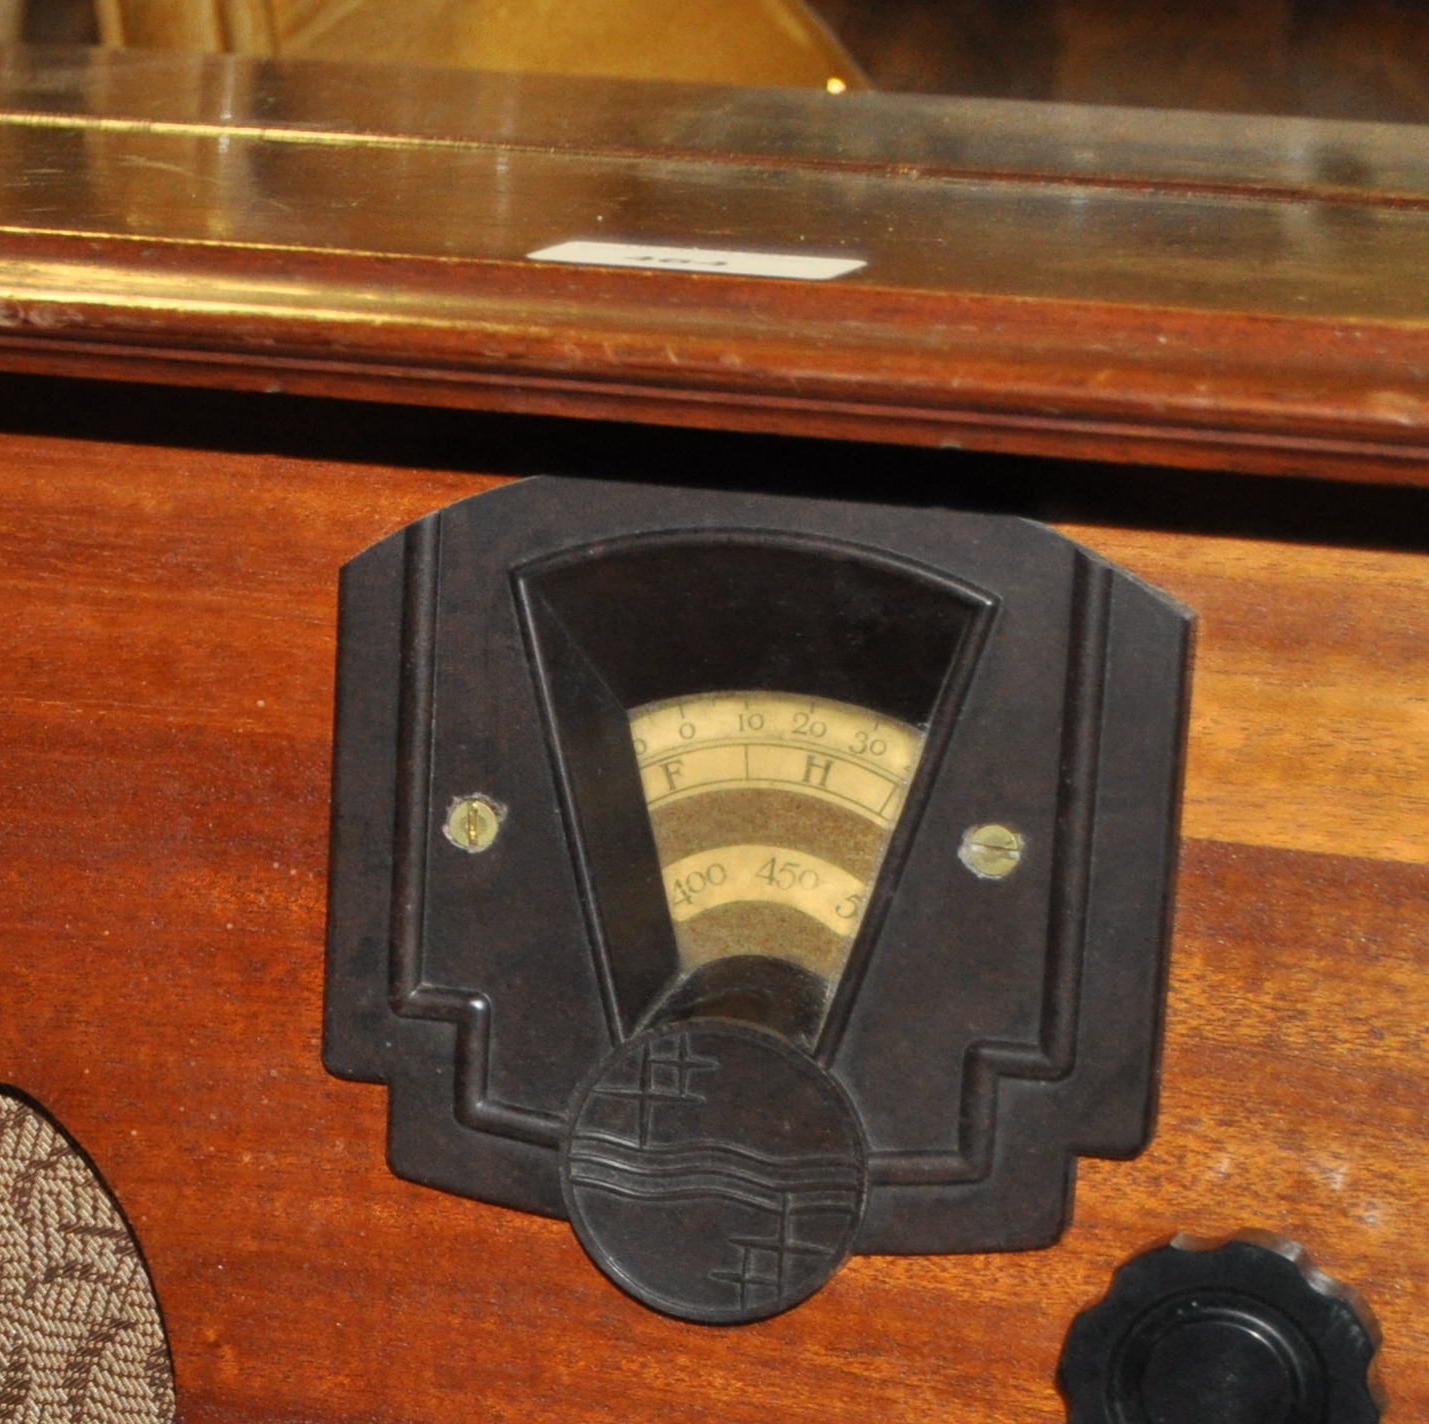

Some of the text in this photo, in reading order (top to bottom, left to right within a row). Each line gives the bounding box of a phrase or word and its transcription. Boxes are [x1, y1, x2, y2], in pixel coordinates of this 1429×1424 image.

[679, 721, 697, 741] 0
[737, 712, 765, 733] 10
[791, 712, 829, 740] 20
[848, 731, 888, 758] 30
[658, 754, 836, 792] F H
[671, 862, 728, 908] 400
[754, 856, 822, 893] 450
